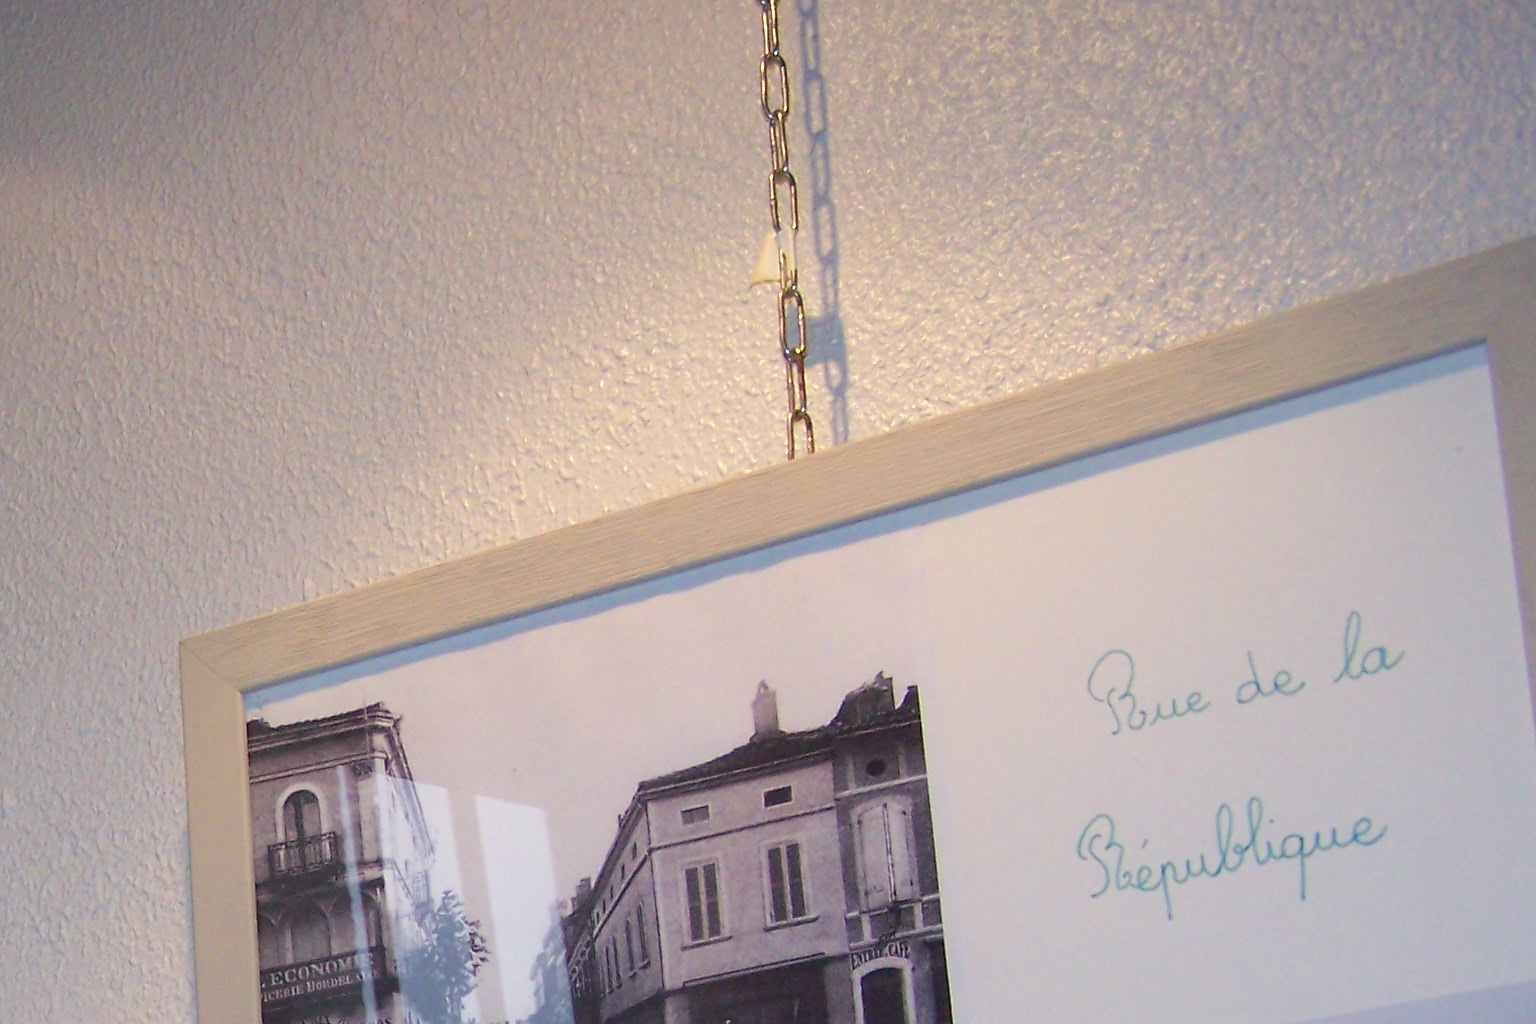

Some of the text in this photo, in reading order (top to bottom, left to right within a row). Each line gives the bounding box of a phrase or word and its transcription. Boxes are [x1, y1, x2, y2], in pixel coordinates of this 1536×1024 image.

[1087, 610, 1405, 735] Rue de la
[1077, 796, 1389, 921] République
